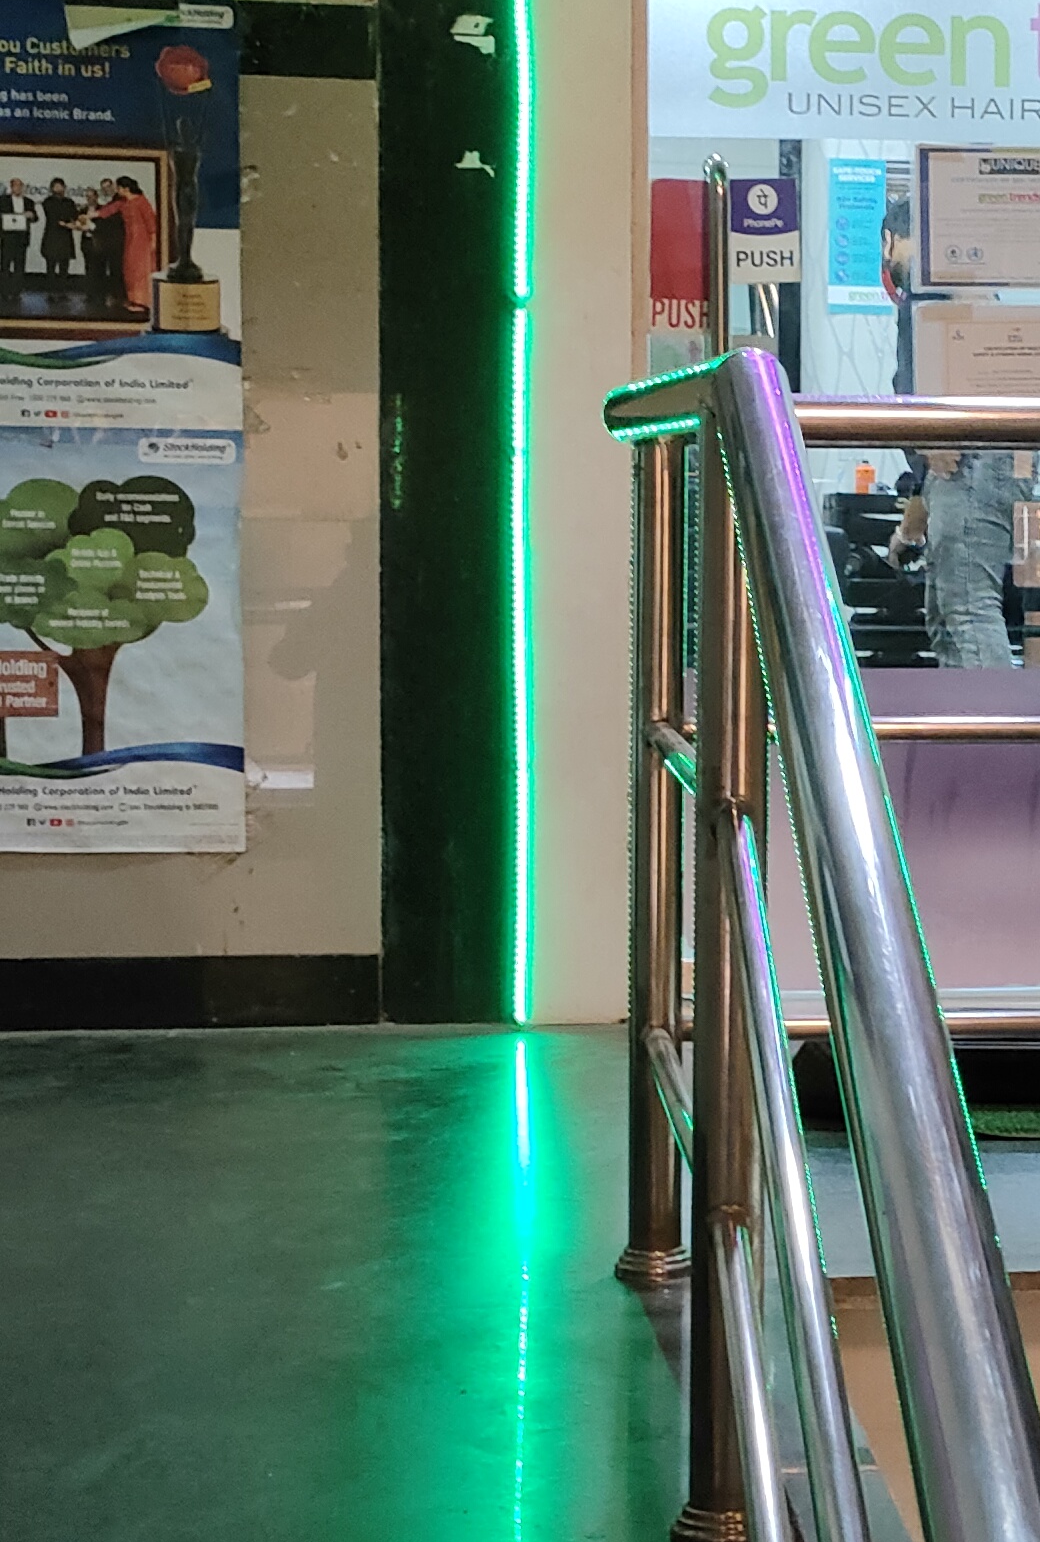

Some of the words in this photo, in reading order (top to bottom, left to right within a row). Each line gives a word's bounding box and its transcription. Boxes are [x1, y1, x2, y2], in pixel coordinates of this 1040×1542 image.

[706, 5, 1011, 108] green
[5, 57, 53, 75] Faith
[58, 60, 76, 77] in
[81, 62, 111, 78] us!
[787, 92, 938, 119] UNISEX
[736, 250, 794, 268] PUSH
[37, 377, 101, 390] Corporation
[6, 695, 48, 709] Partner
[42, 785, 105, 798] Corporation
